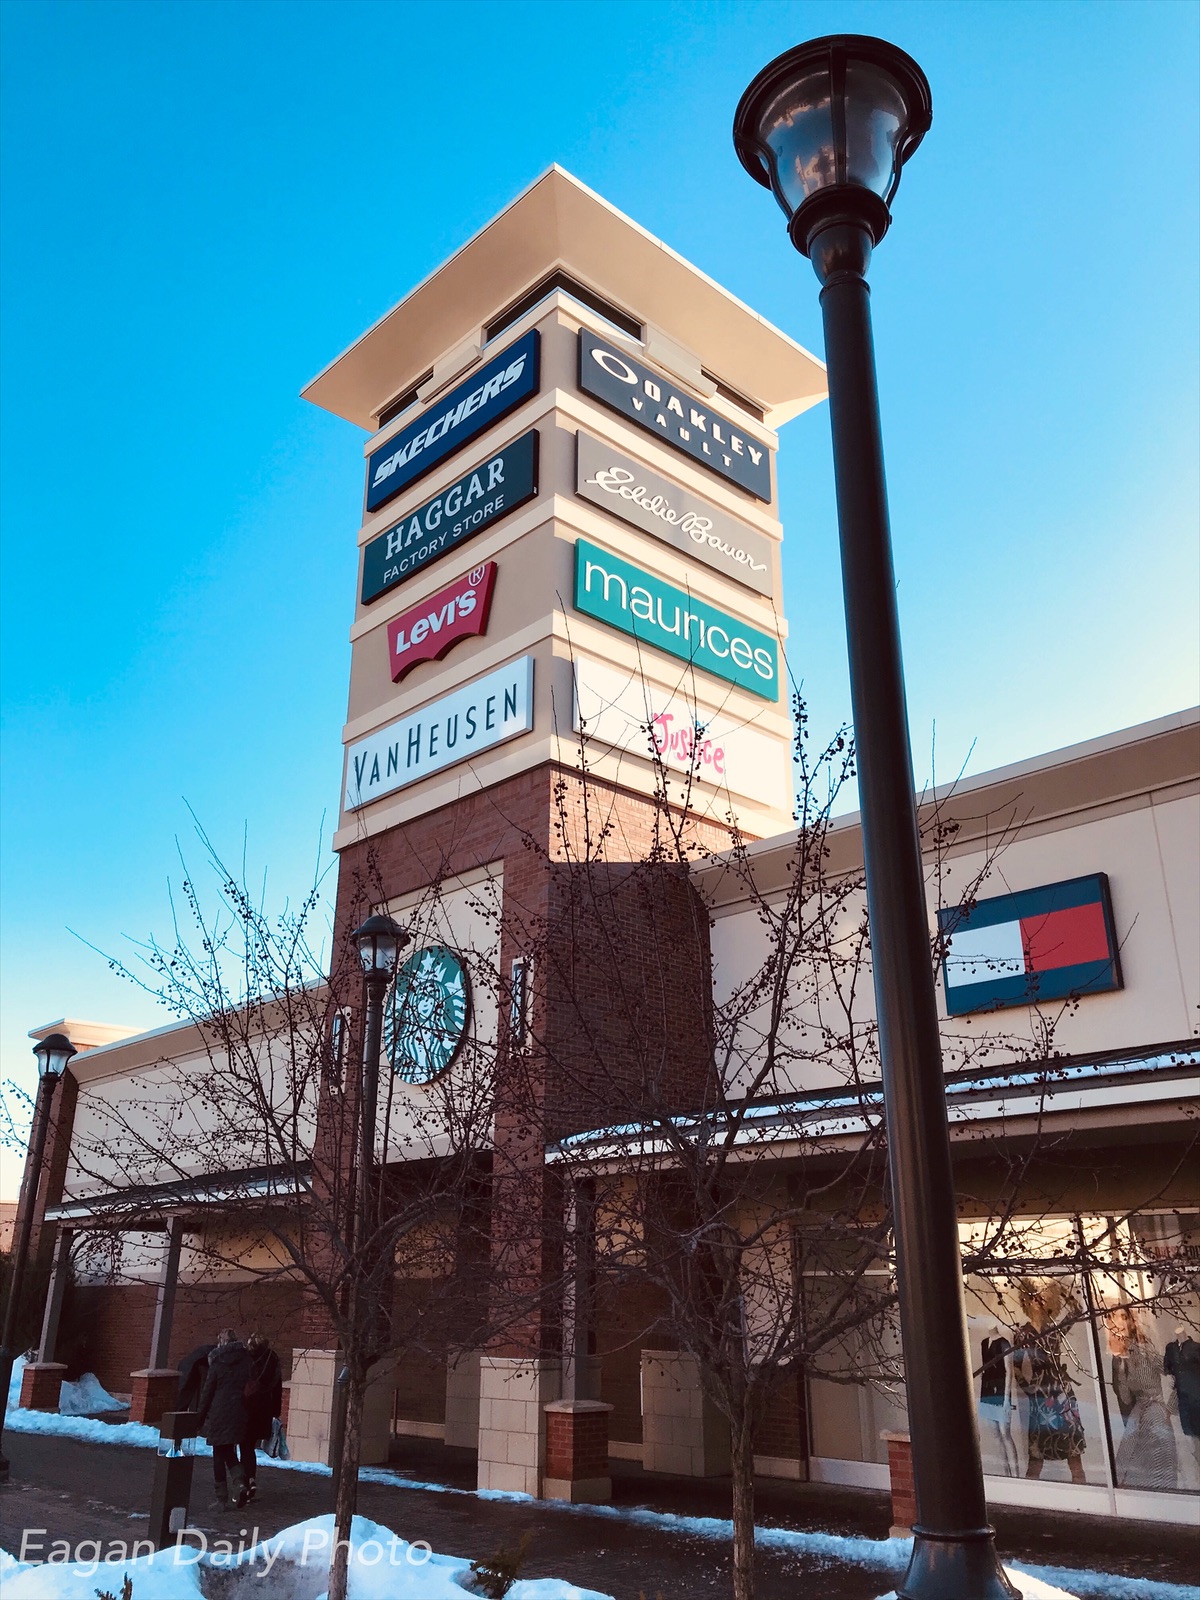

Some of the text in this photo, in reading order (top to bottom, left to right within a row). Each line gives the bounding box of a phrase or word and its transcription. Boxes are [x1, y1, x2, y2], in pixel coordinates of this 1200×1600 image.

[371, 352, 528, 489] SKECHERS
[631, 396, 732, 468] VAULT
[643, 379, 764, 466] OAKLEY
[383, 494, 505, 584] FACTORY STORE
[385, 457, 505, 561] HAGGAR
[585, 466, 768, 572] Eddie Bauer
[584, 559, 774, 680] maurices
[652, 712, 725, 775] Justice
